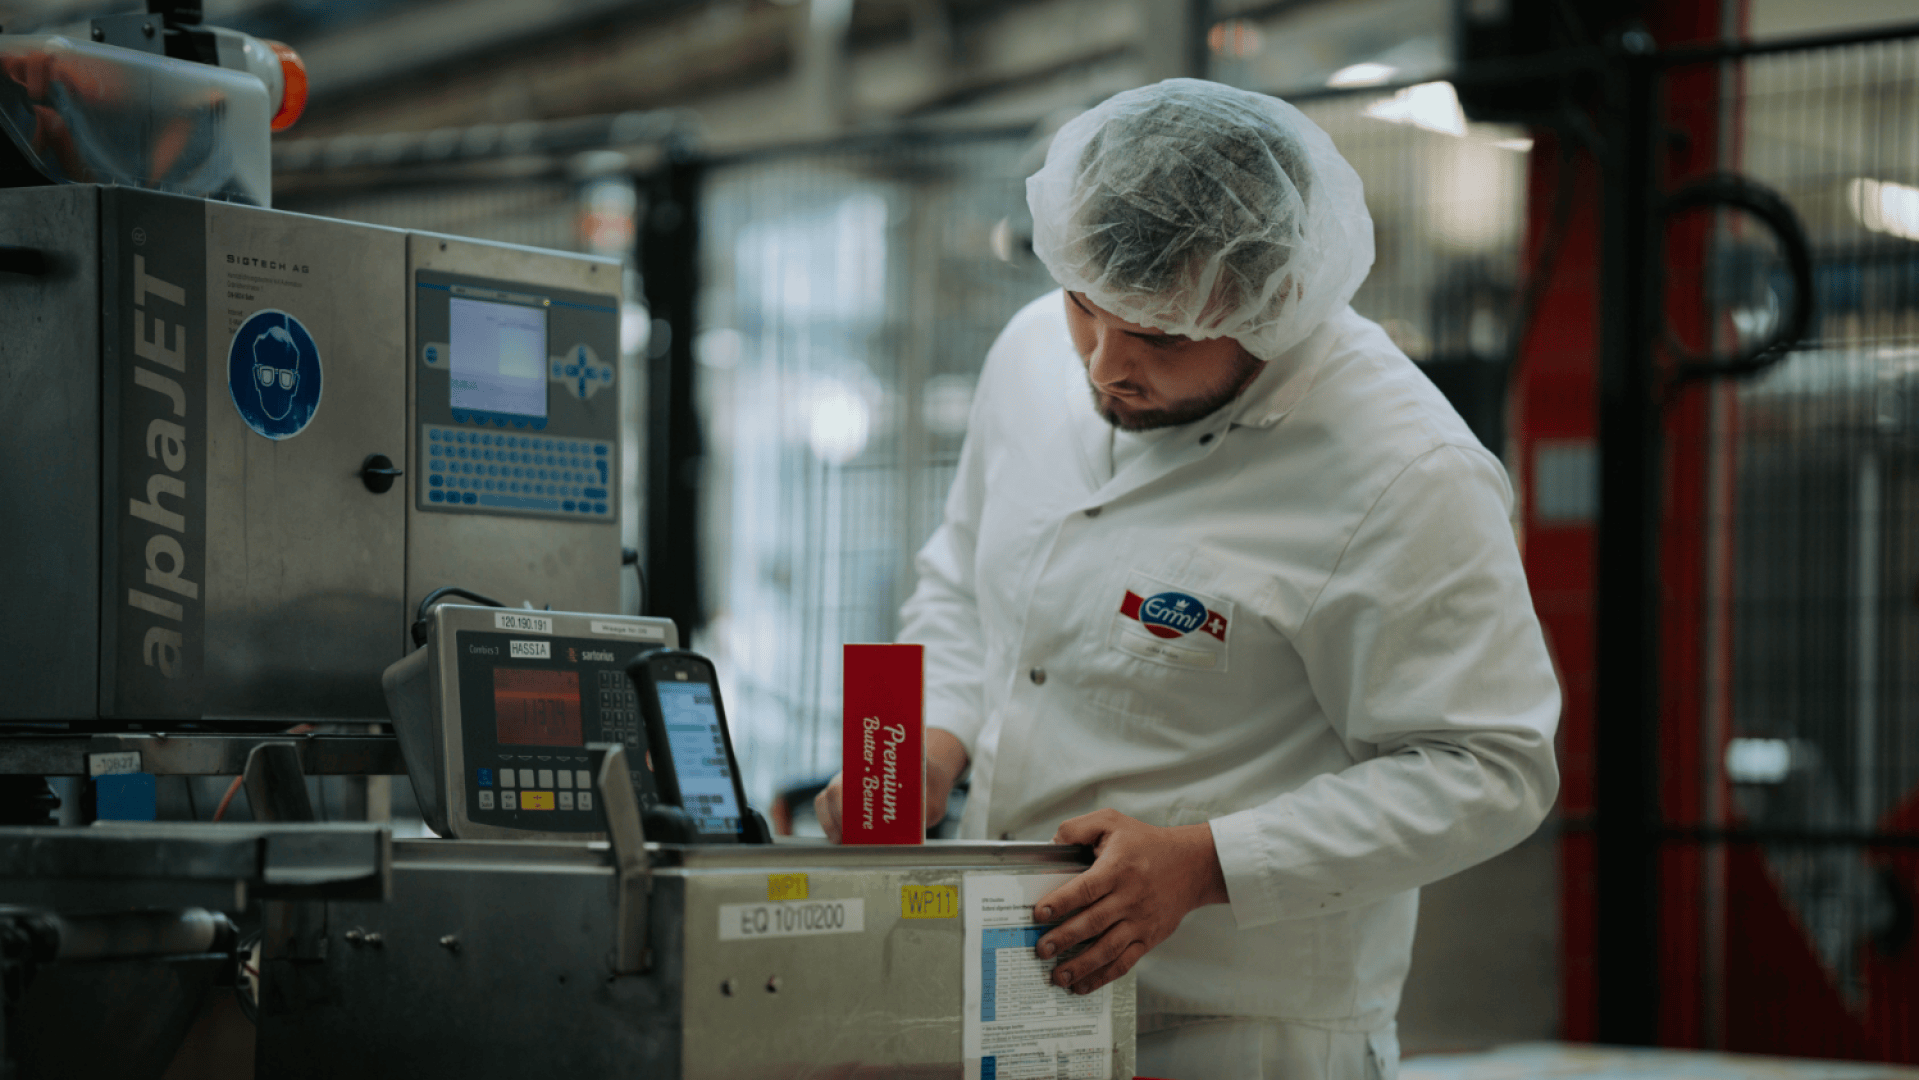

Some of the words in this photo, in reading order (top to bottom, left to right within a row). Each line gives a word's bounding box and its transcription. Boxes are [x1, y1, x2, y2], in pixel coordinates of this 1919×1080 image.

[226, 254, 287, 271] SIGTECH
[292, 264, 310, 274] AG
[501, 615, 547, 632] 120.190.191
[1144, 597, 1202, 629] Emmi
[511, 641, 547, 657] HASSIA
[582, 650, 615, 663] sartorius
[863, 716, 880, 765] Butter
[882, 723, 906, 824] Premium
[862, 775, 880, 830] Beurre
[909, 889, 952, 914] WP11
[741, 907, 769, 934] EQ
[775, 903, 845, 932] 1010200
